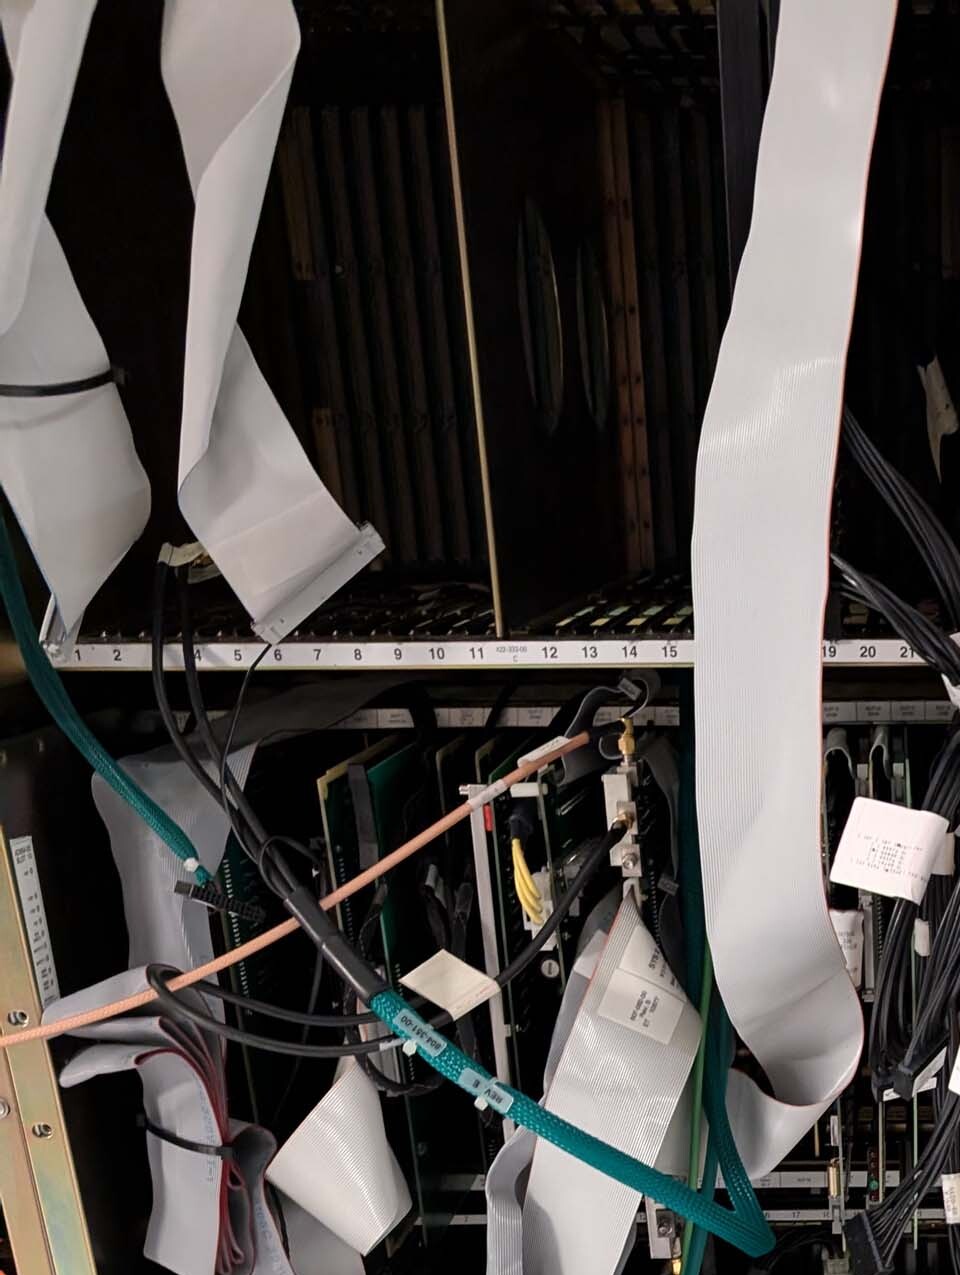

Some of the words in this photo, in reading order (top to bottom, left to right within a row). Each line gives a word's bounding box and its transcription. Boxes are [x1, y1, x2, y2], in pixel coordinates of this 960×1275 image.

[75, 649, 81, 661] 1
[113, 649, 122, 661] 2
[234, 649, 242, 661] 5
[274, 649, 282, 661] 6
[314, 649, 322, 661] 7
[354, 649, 362, 661] 8
[394, 648, 402, 660] 9
[430, 648, 445, 660] 10
[469, 647, 484, 660] 11
[541, 647, 558, 659] 12
[582, 646, 598, 659] 13
[622, 646, 638, 658] 14
[661, 646, 677, 658] 15
[860, 646, 876, 657] 20
[900, 646, 914, 658] 21
[484, 1088, 503, 1104] REV
